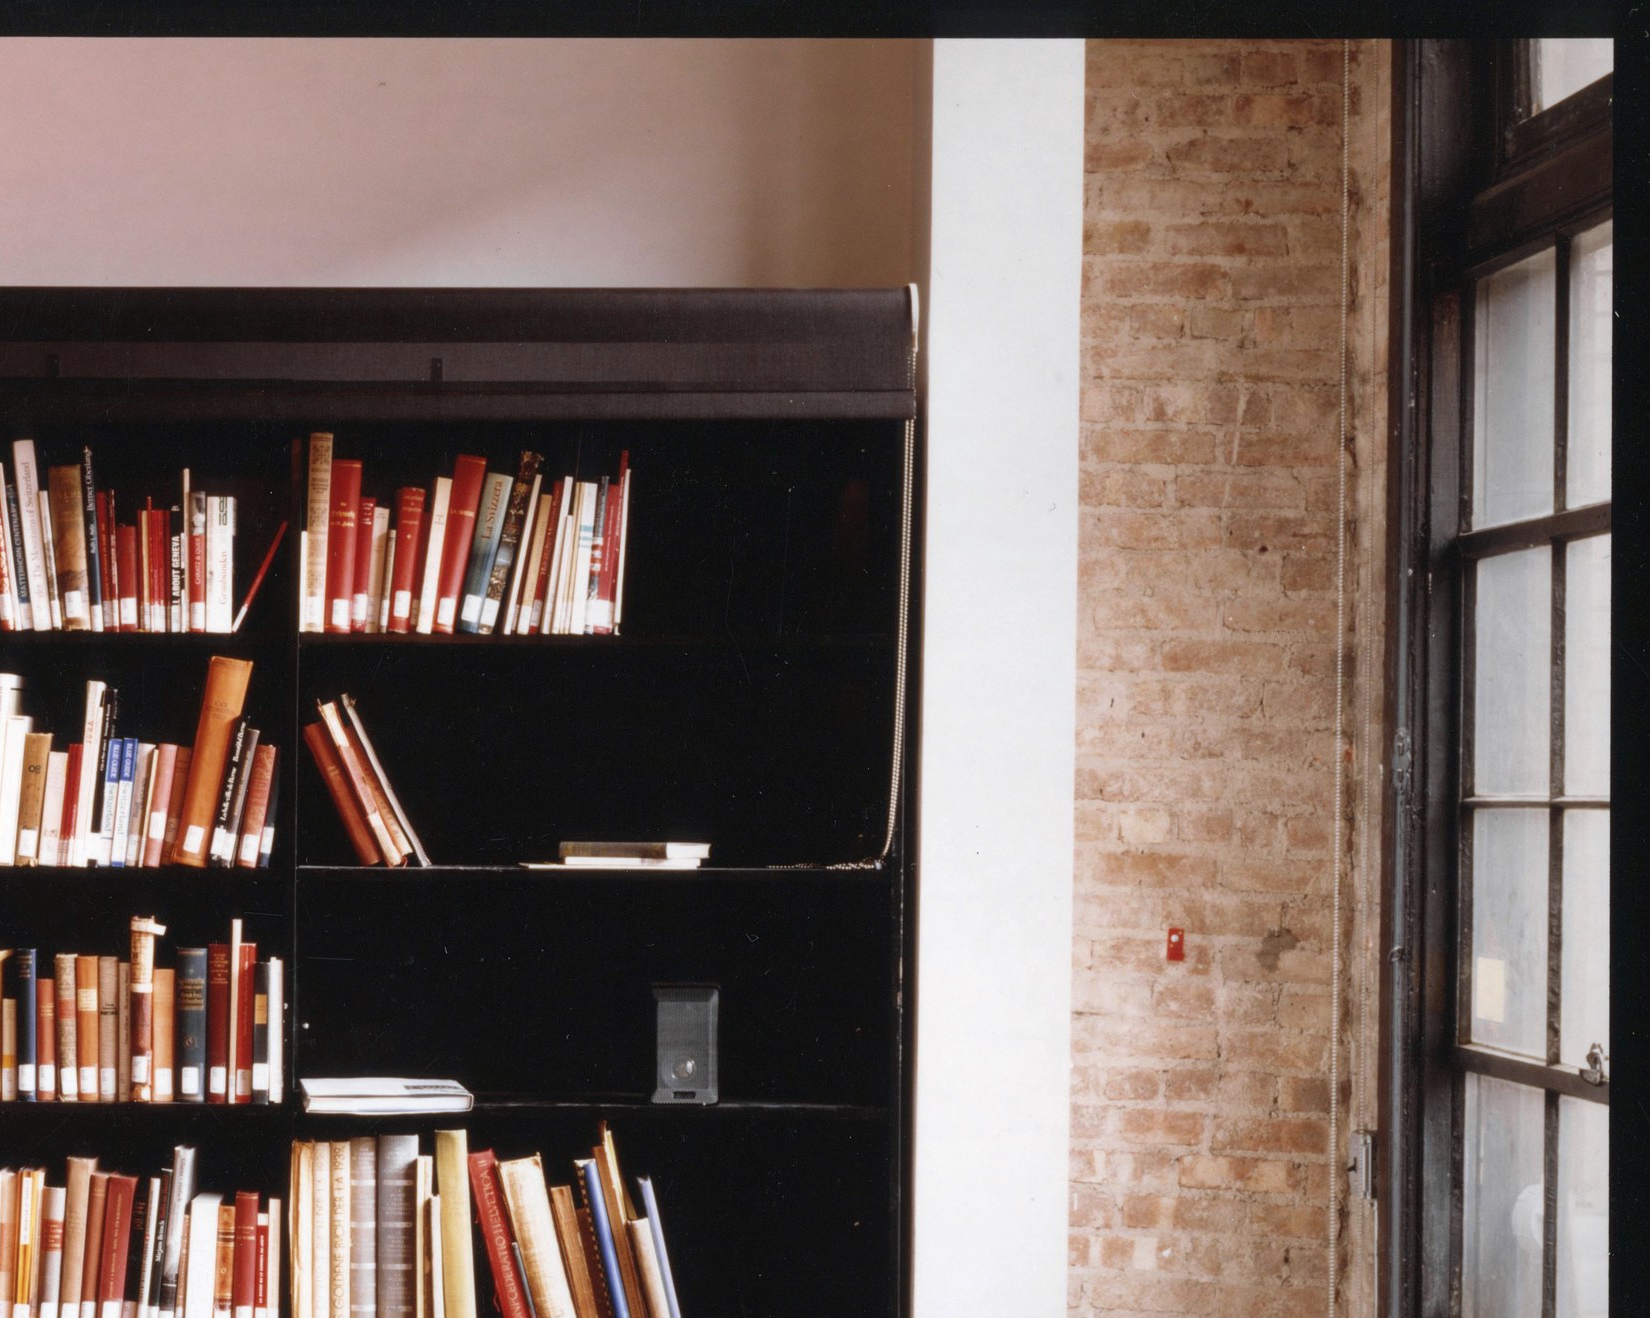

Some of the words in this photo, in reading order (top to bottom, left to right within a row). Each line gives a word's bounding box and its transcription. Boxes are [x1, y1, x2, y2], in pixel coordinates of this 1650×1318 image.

[20, 461, 34, 508] Switzerland
[85, 485, 94, 512] Berner
[484, 480, 504, 524] Svizzera
[10, 503, 22, 546] CENTENARY
[480, 527, 493, 541] La
[171, 535, 181, 568] GENEVA
[14, 548, 28, 598] MATTERHORN
[171, 569, 181, 597] ABOUT
[85, 719, 95, 745] JURA
[112, 744, 120, 760] BLUE
[125, 742, 134, 758] BLUE
[109, 760, 119, 779] GUIDE
[123, 758, 132, 778] GUIDE
[104, 783, 116, 833] Switzerland
[117, 782, 131, 835] Switzerland
[333, 1196, 345, 1216] DER
[480, 1171, 505, 1235] HELVETICA
[332, 1220, 345, 1249] BVCH
[332, 1254, 345, 1310] GOLDENE
